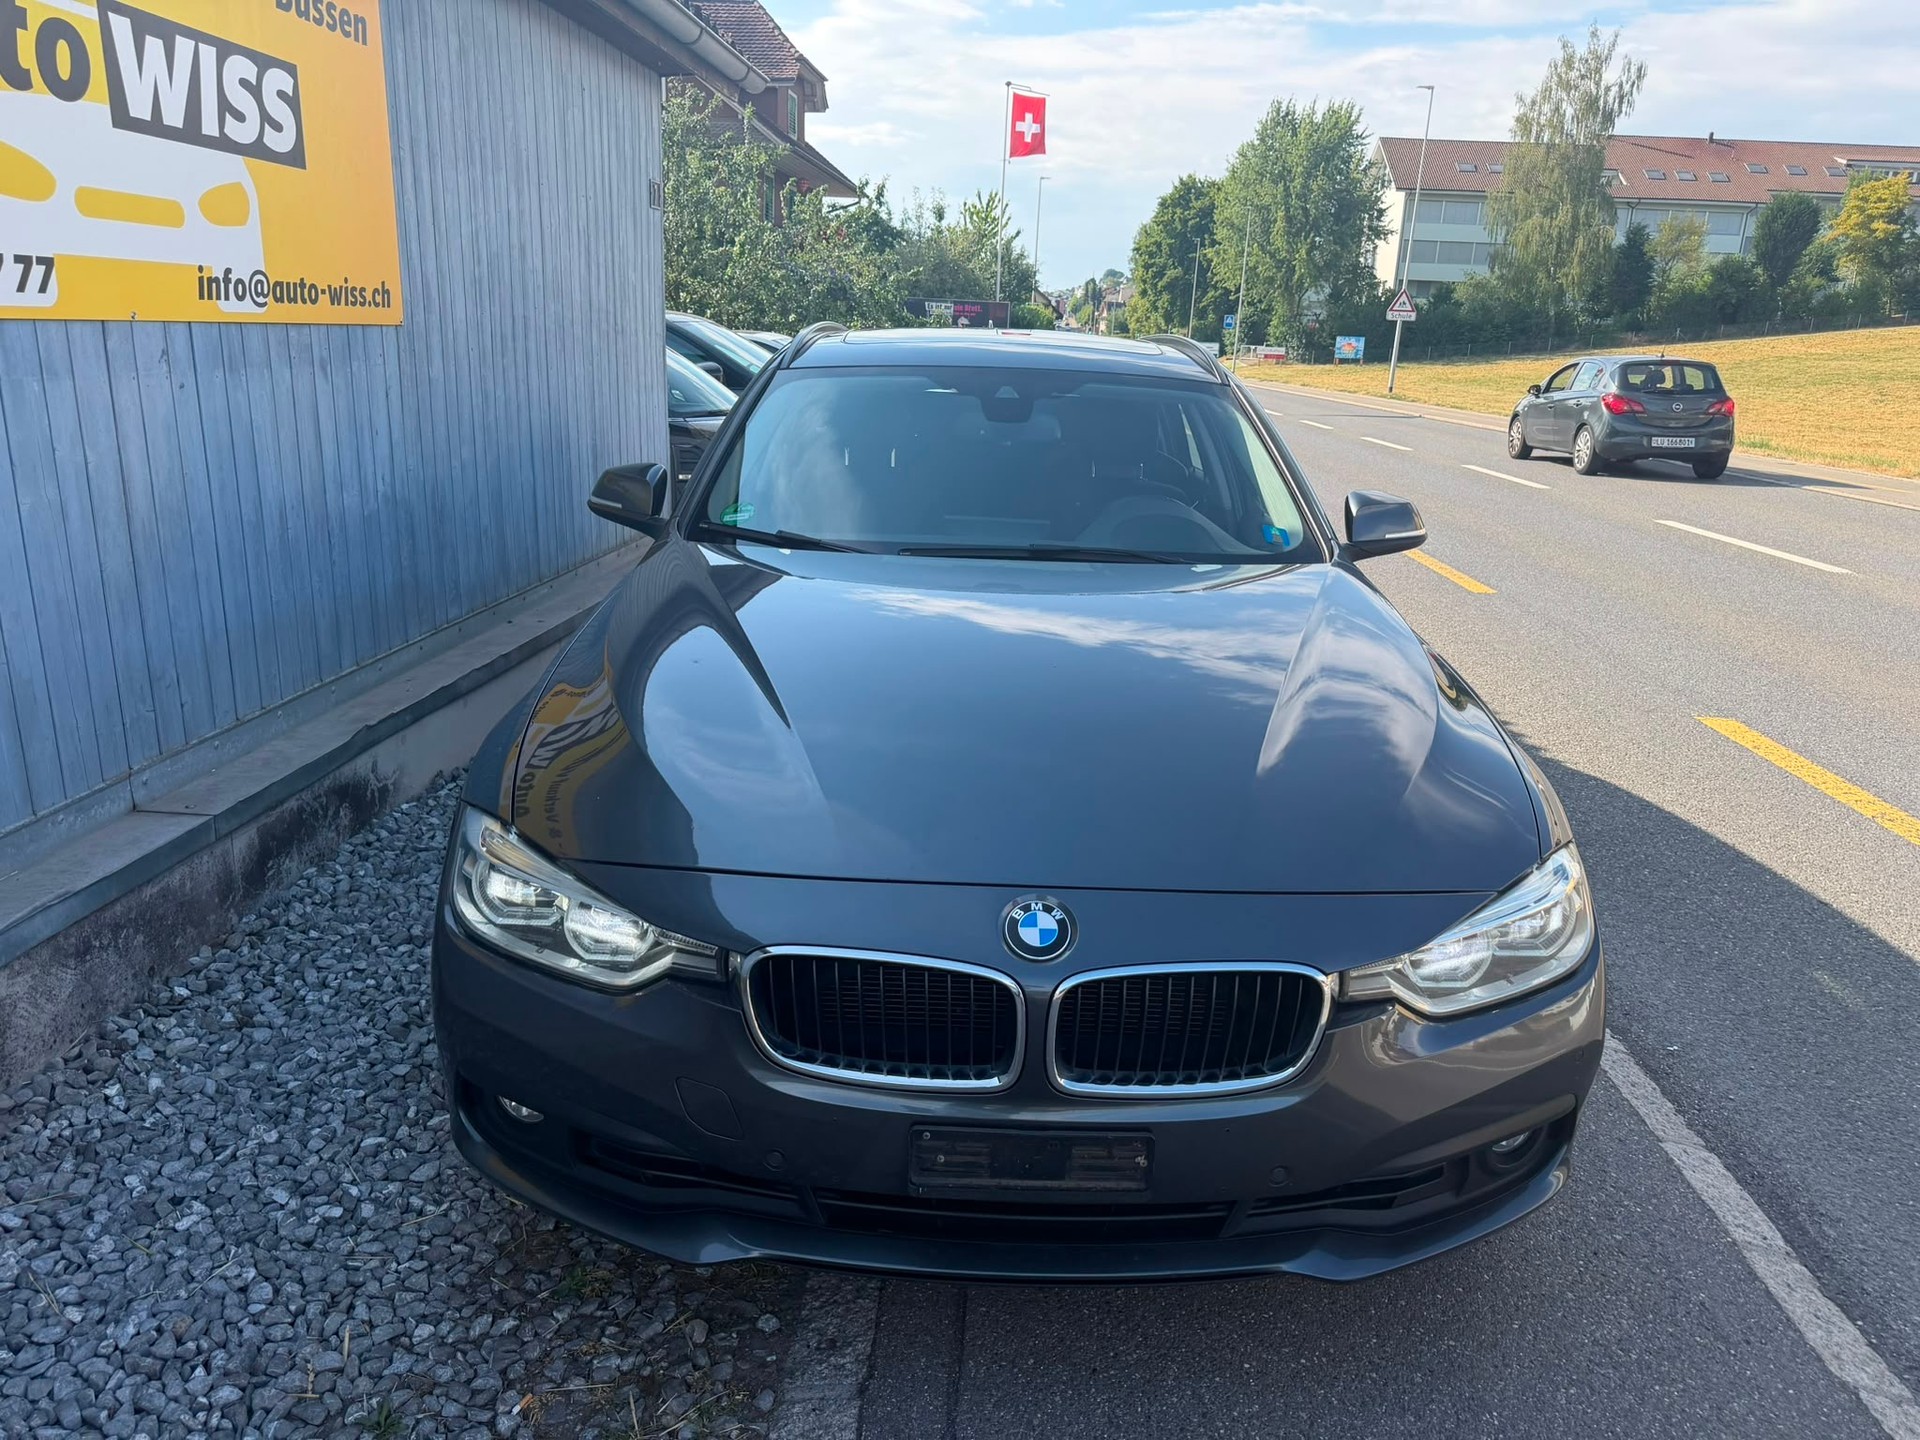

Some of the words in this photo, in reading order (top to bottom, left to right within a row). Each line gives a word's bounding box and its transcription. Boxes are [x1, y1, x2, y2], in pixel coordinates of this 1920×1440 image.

[107, 10, 297, 153] WISS
[13, 253, 55, 294] 77
[197, 265, 391, 309] info@auto-wiss.ch
[1011, 902, 1065, 921] BMW
